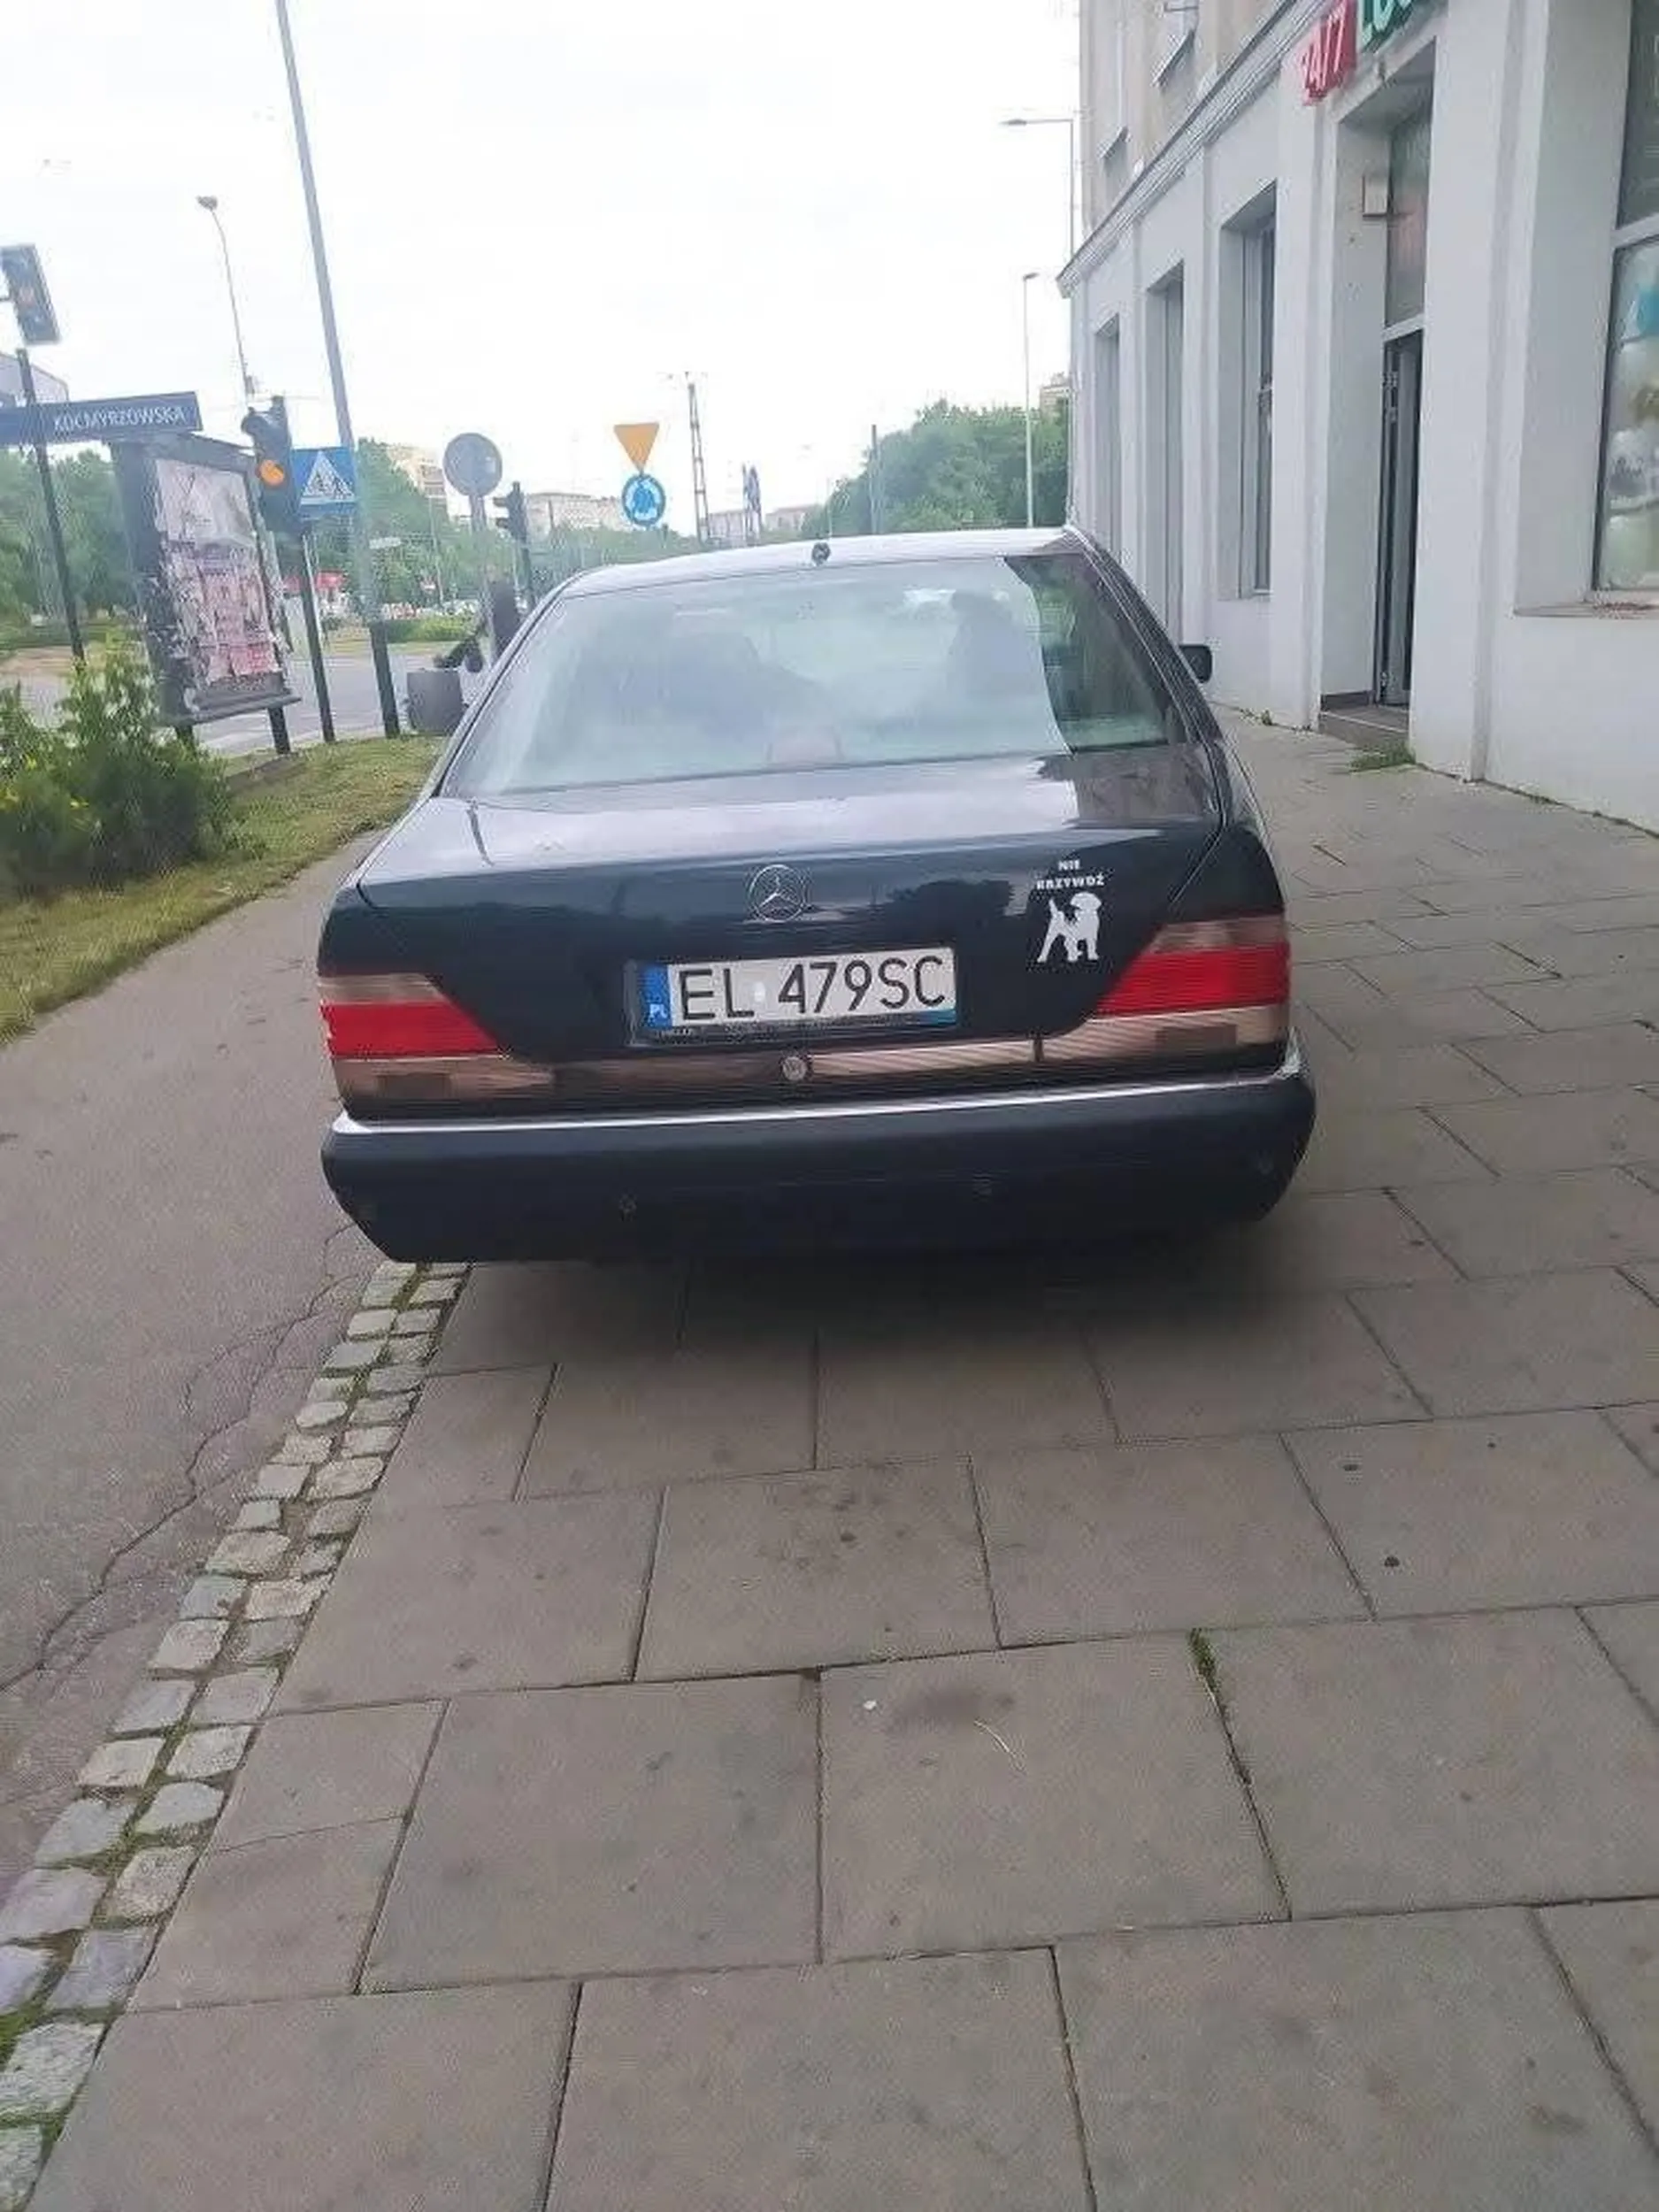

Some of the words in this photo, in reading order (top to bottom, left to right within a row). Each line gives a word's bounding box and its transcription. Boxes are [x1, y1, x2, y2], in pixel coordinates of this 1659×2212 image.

[54, 406, 185, 431] KOCMYRZOWSKA
[679, 968, 755, 1020] EL
[777, 956, 945, 1015] 479SC
[649, 1004, 668, 1018] PL
